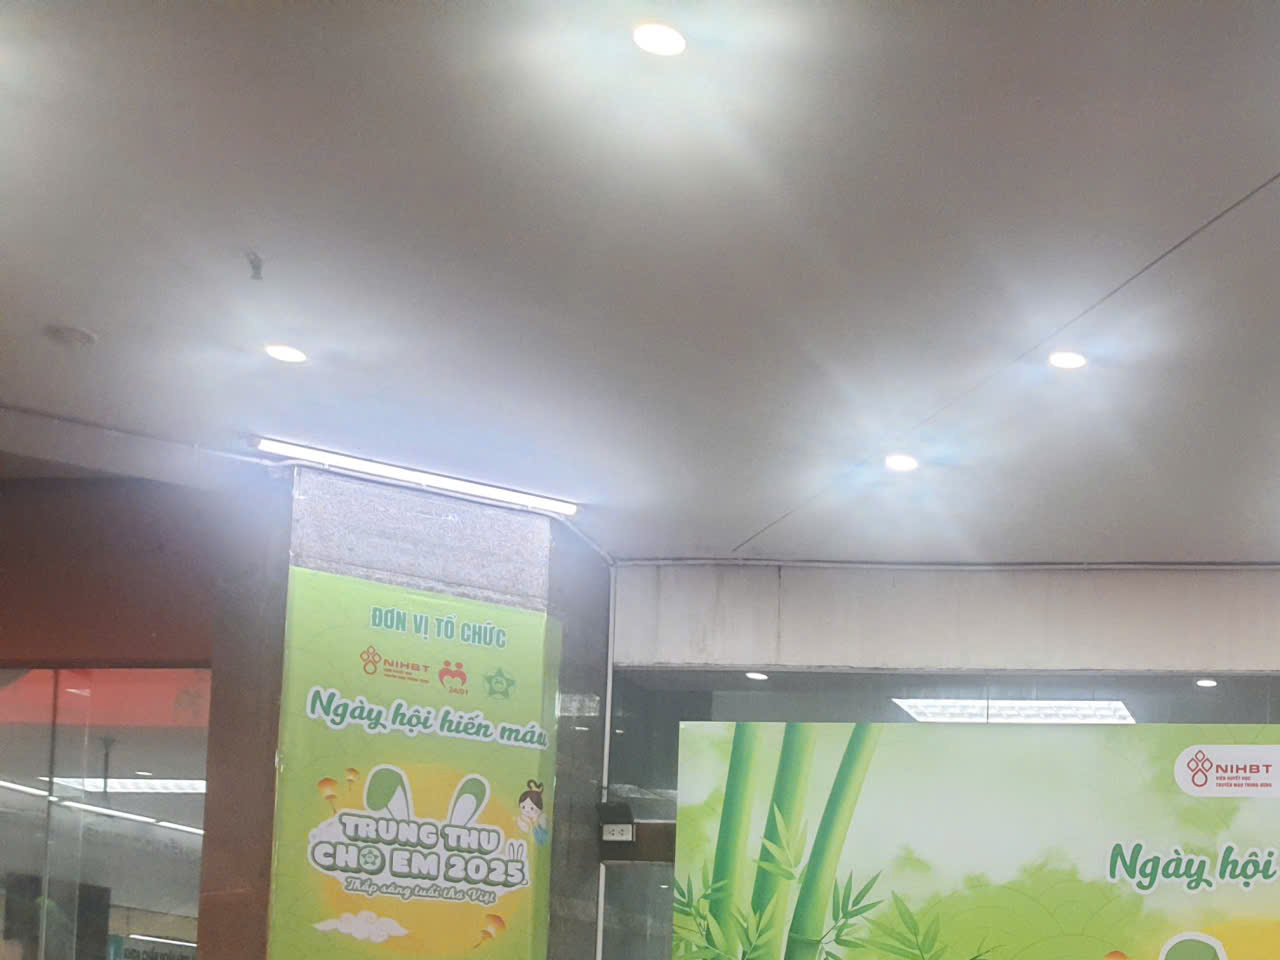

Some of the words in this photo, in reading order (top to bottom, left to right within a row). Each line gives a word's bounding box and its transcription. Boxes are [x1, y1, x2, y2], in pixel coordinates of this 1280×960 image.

[310, 689, 388, 731] Ngày
[392, 702, 432, 734] hội
[439, 709, 493, 738] hiến
[500, 724, 548, 748] máu
[1216, 764, 1272, 774] NIHBT
[339, 812, 439, 849] TRUNG
[440, 825, 501, 855] THU
[312, 840, 386, 875] CHO
[390, 848, 440, 880] EM
[443, 853, 526, 887] 2025
[1110, 843, 1213, 891] Ngày
[1218, 845, 1277, 888] hội
